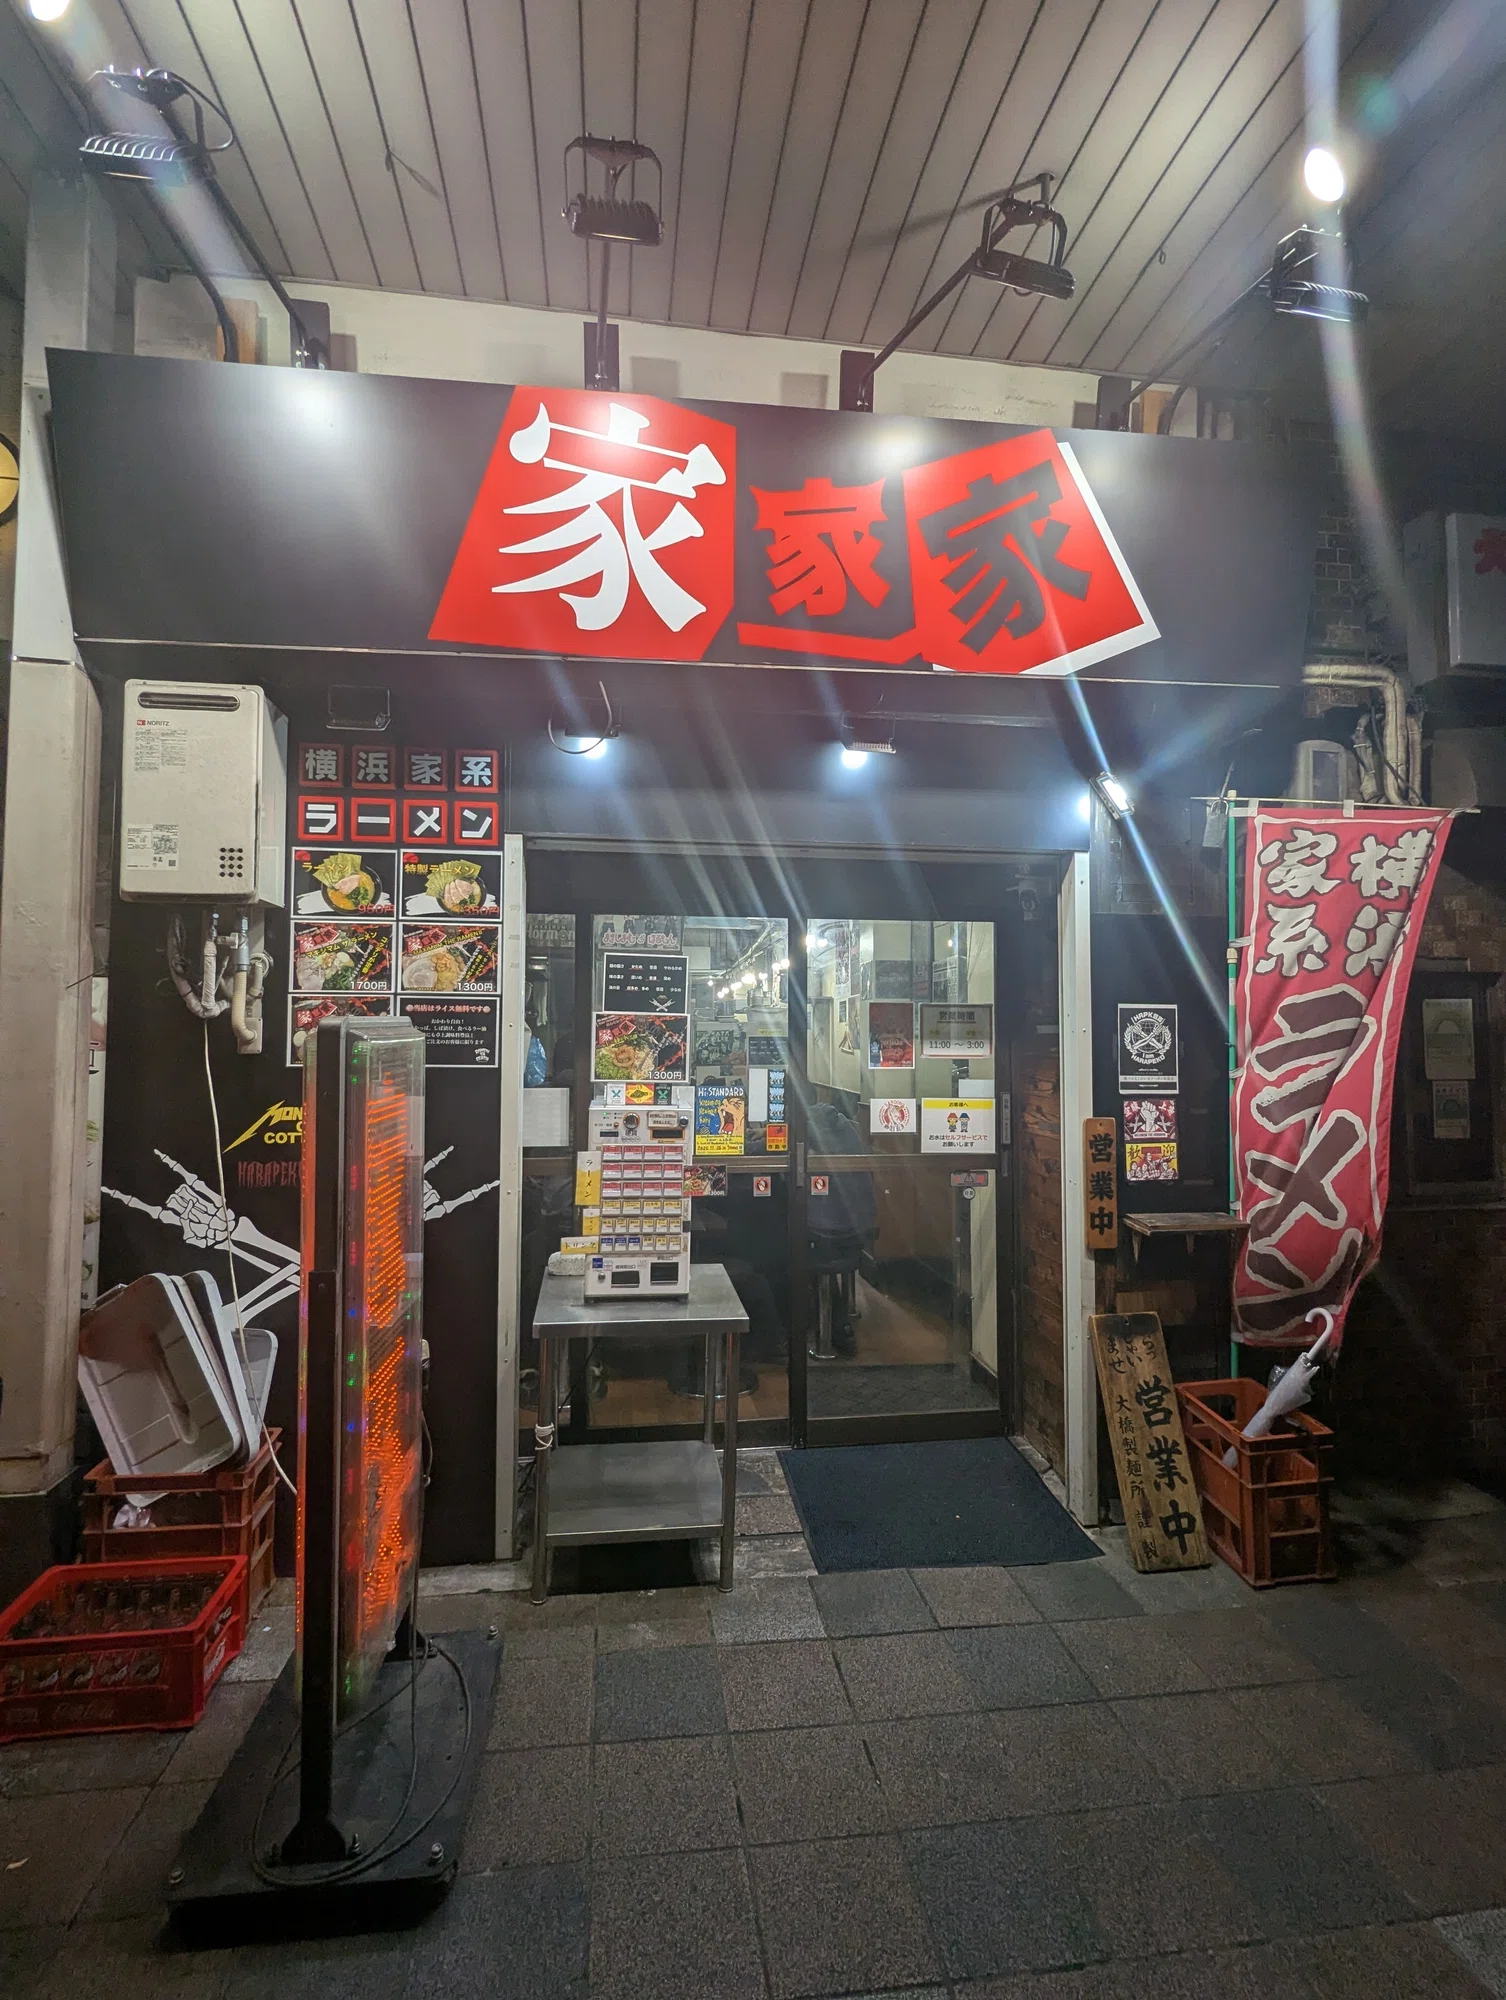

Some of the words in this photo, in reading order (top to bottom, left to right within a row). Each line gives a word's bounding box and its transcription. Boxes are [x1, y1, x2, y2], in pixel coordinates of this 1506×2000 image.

[305, 748, 492, 787] 横浜家系
[305, 803, 493, 839] ラーメン
[302, 862, 350, 873] ラーメン
[404, 863, 475, 875] 特製ラーメン
[1253, 827, 1343, 978] 家系
[350, 981, 387, 990] 1700円
[457, 982, 493, 992] 1300円
[928, 1040, 951, 1049] 11:00
[966, 1040, 985, 1049] 3:00
[1130, 1053, 1166, 1065] HARAPEKO
[648, 1071, 682, 1080] 1300円
[1234, 983, 1378, 1338] ラメン
[238, 1161, 303, 1188] HARAPEK
[585, 1159, 593, 1198] ラーメン
[1089, 1132, 1114, 1236] 営業中
[1134, 1375, 1197, 1556] 営業中
